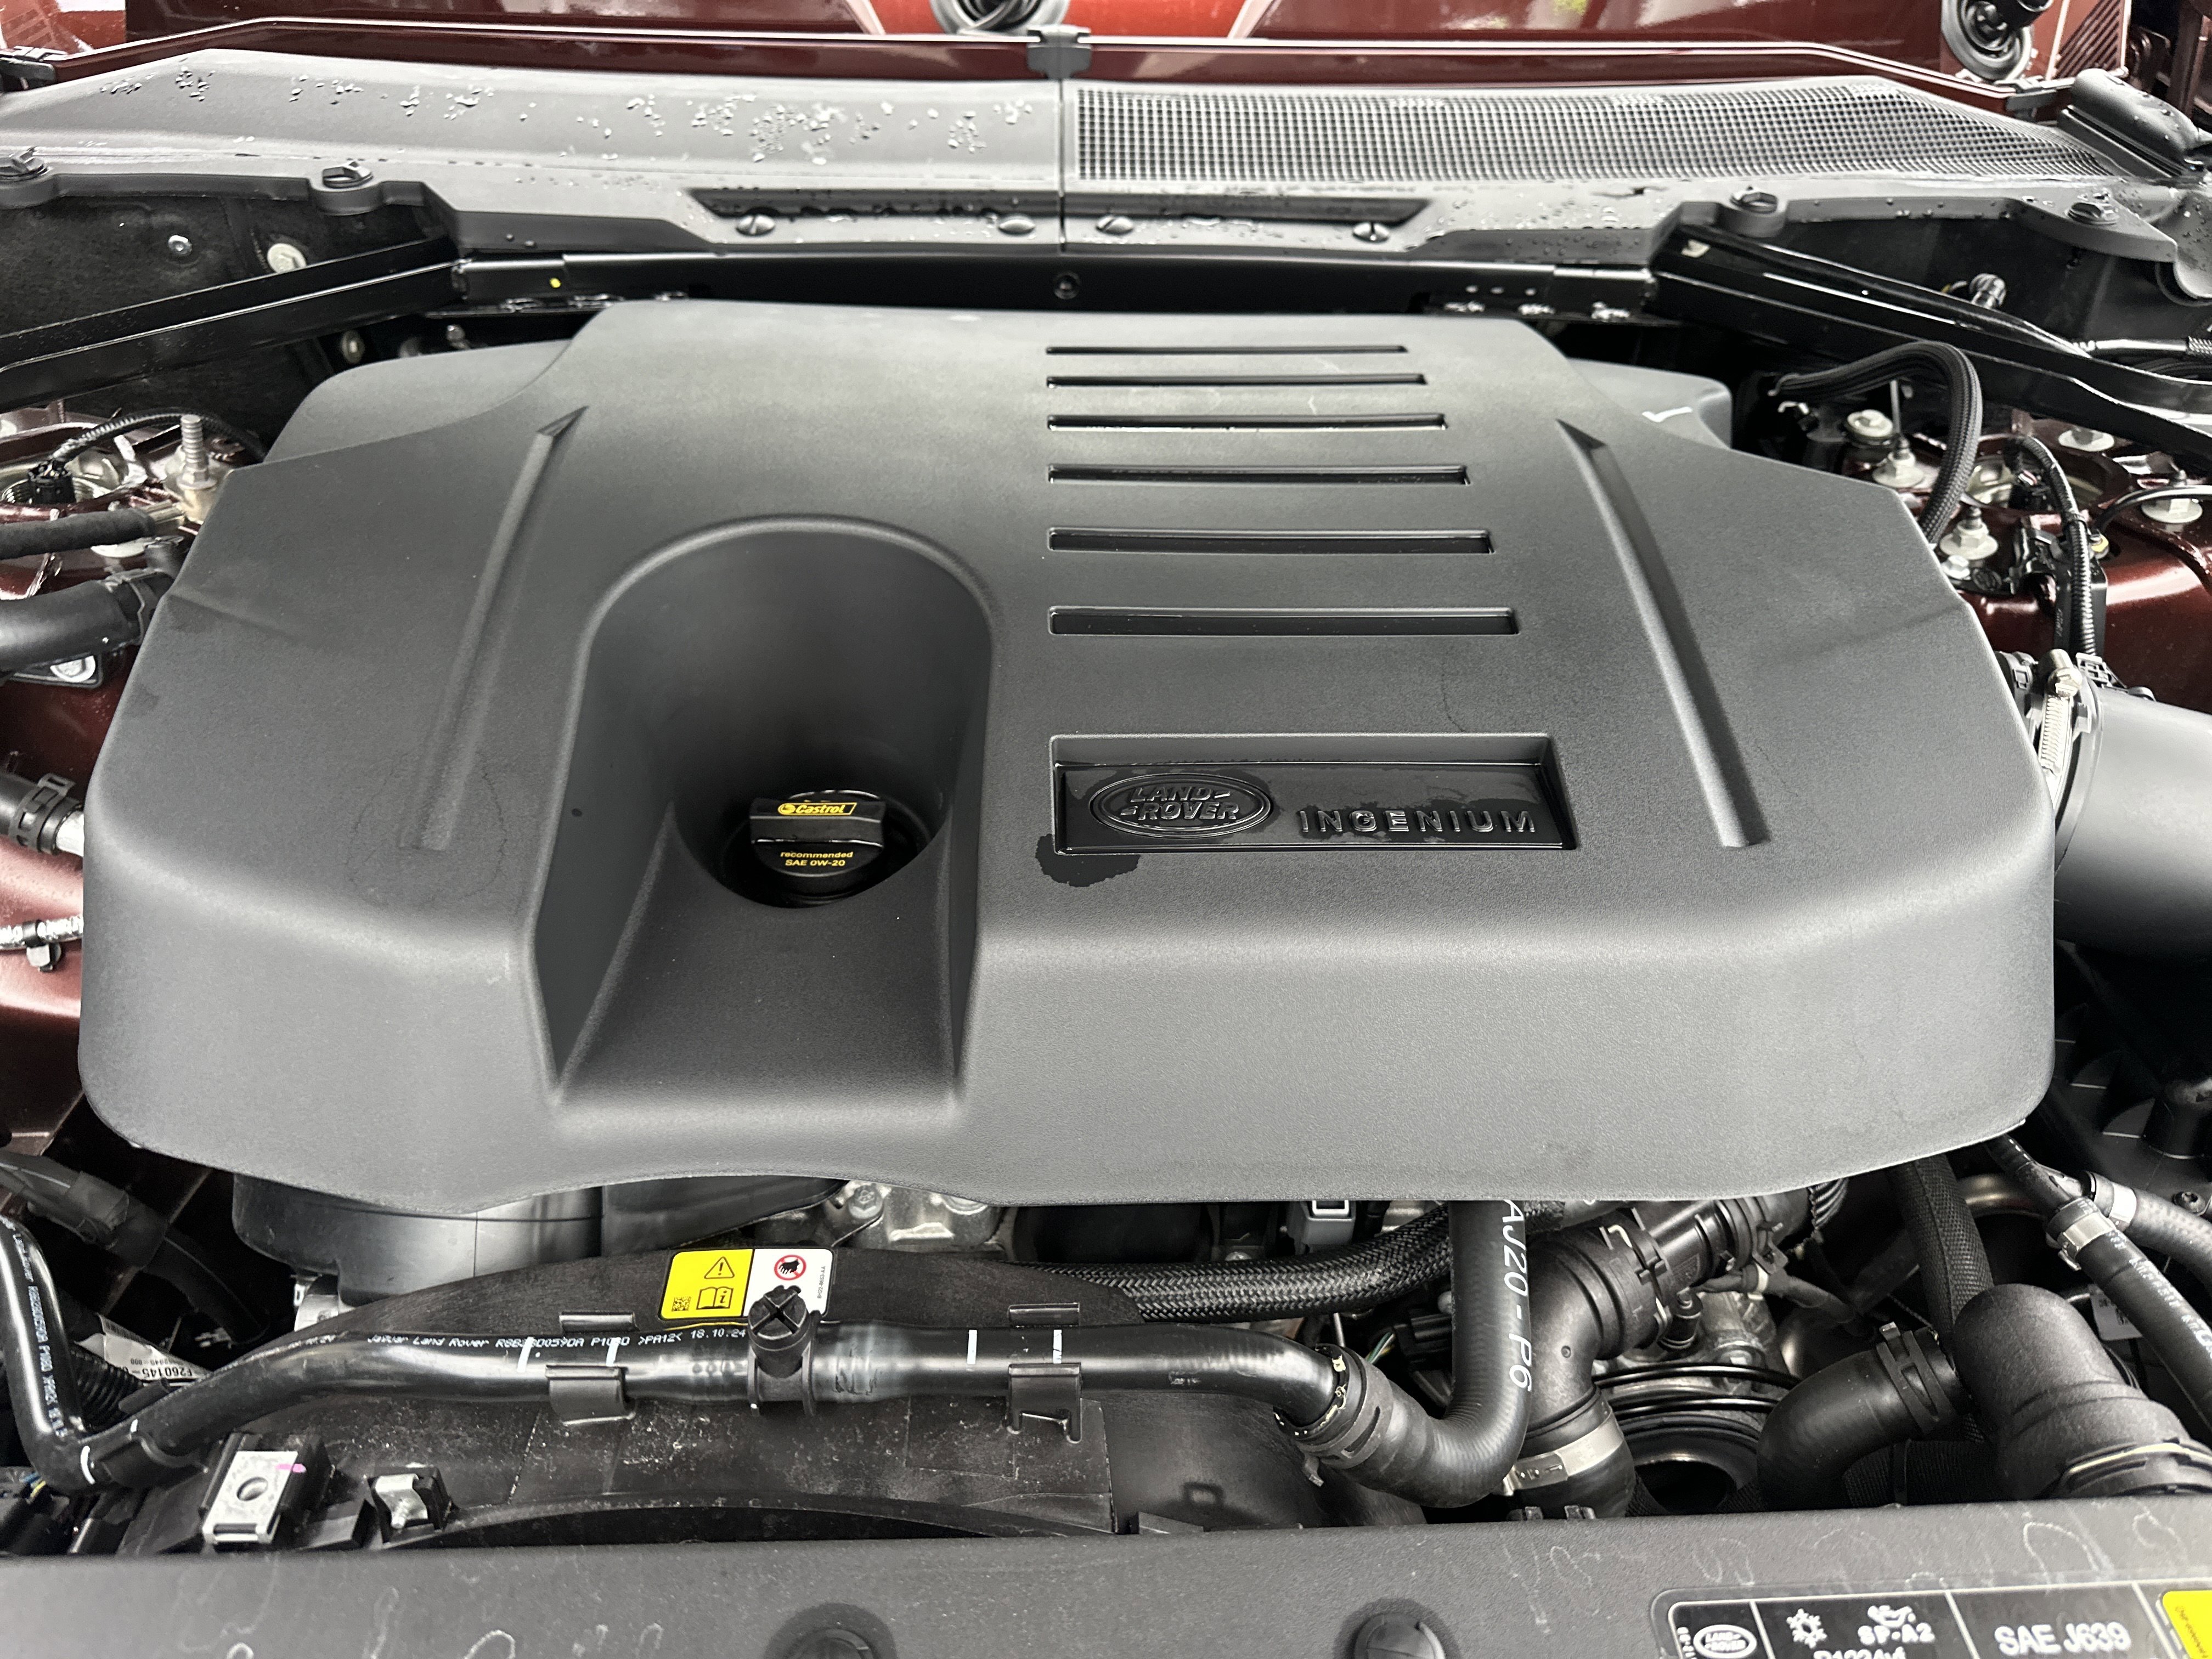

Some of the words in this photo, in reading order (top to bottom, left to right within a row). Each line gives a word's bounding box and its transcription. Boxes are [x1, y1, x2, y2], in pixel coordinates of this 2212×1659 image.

[795, 804, 846, 814] Castrol
[1298, 810, 1536, 832] INGENIUM
[413, 1336, 445, 1345] Land
[449, 1337, 490, 1347] Rover
[691, 1328, 746, 1340] 18.10.24
[1994, 1624, 2061, 1656] SAE
[2063, 1621, 2132, 1654] J639
